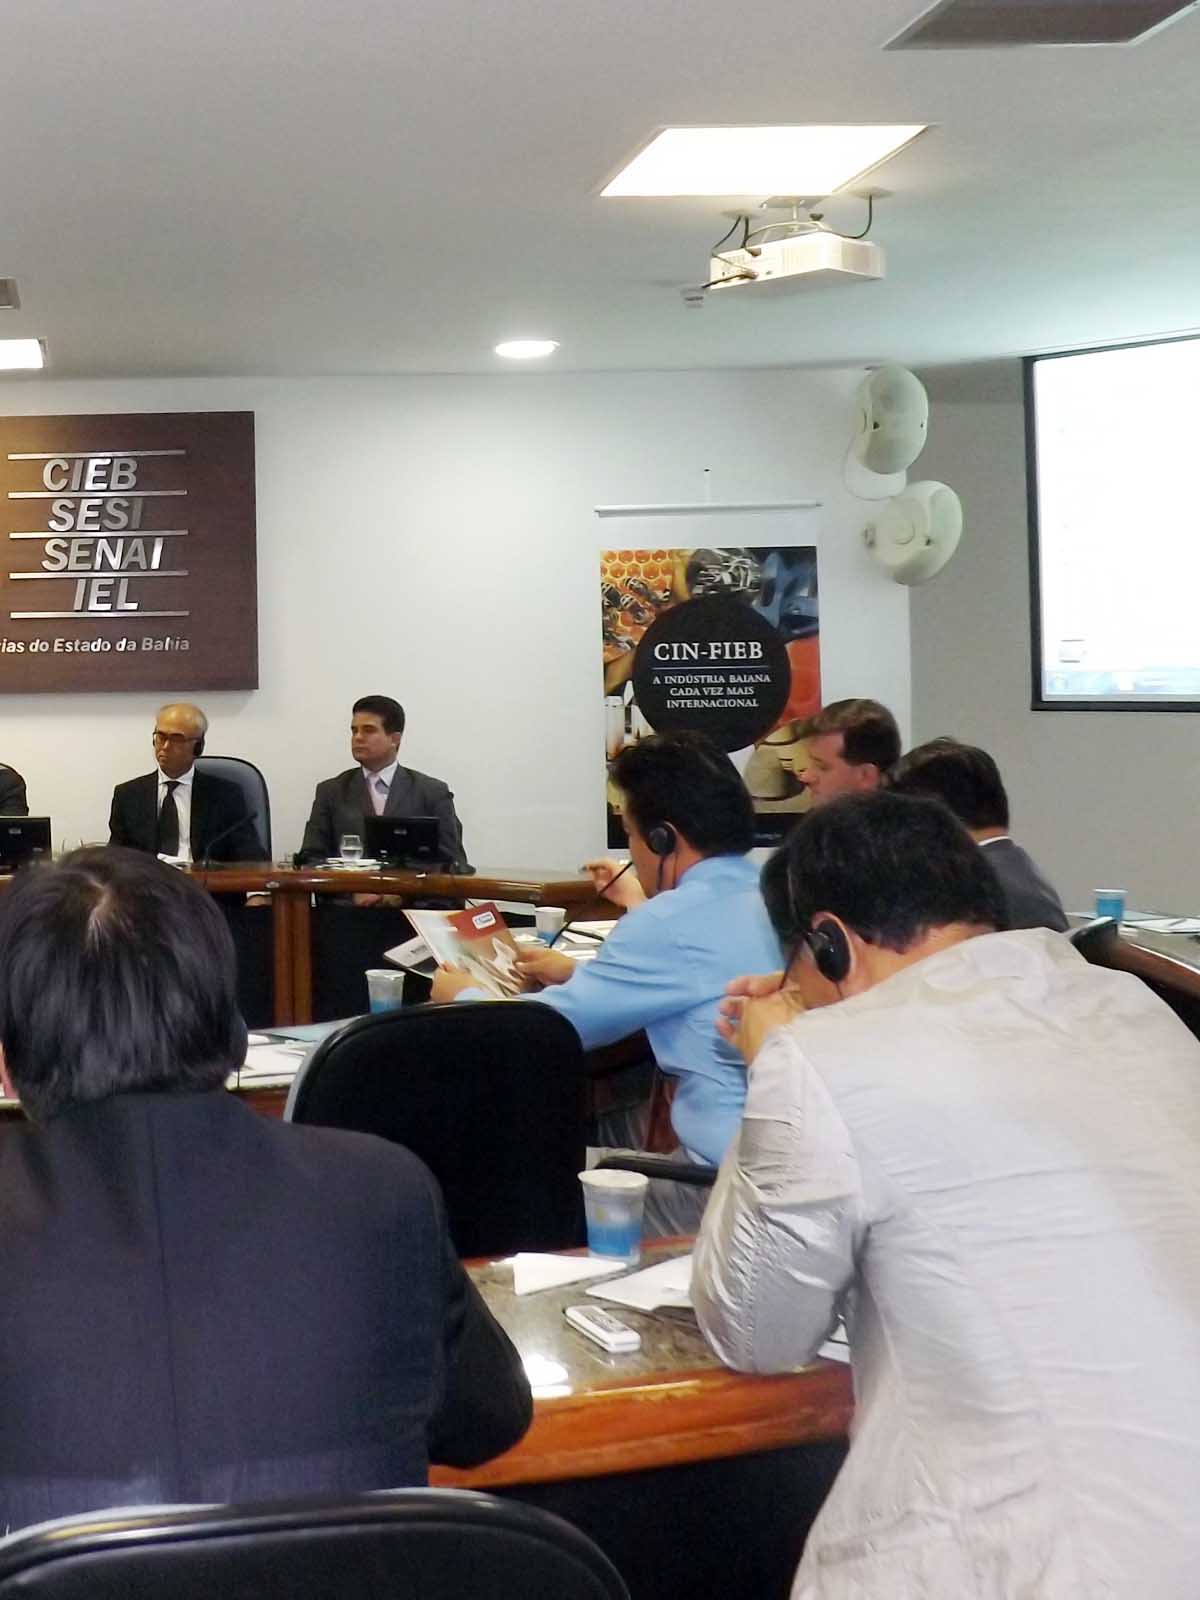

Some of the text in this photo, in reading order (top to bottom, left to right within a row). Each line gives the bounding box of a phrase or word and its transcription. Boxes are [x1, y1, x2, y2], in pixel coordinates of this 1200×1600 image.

[42, 458, 138, 491] CIEB
[48, 497, 144, 532] SESI
[41, 537, 165, 571] SENAI
[73, 578, 139, 611] IEL
[28, 638, 50, 653] do
[53, 637, 112, 653] Estado
[115, 636, 137, 652] da
[141, 636, 191, 651] Bahia
[653, 641, 764, 661] CIN-FIEB
[652, 673, 771, 685] A INDÚSTRIA BAIANA
[669, 685, 755, 697] CADA VEZ MAIS
[666, 698, 760, 709] INTERNACIONAL
